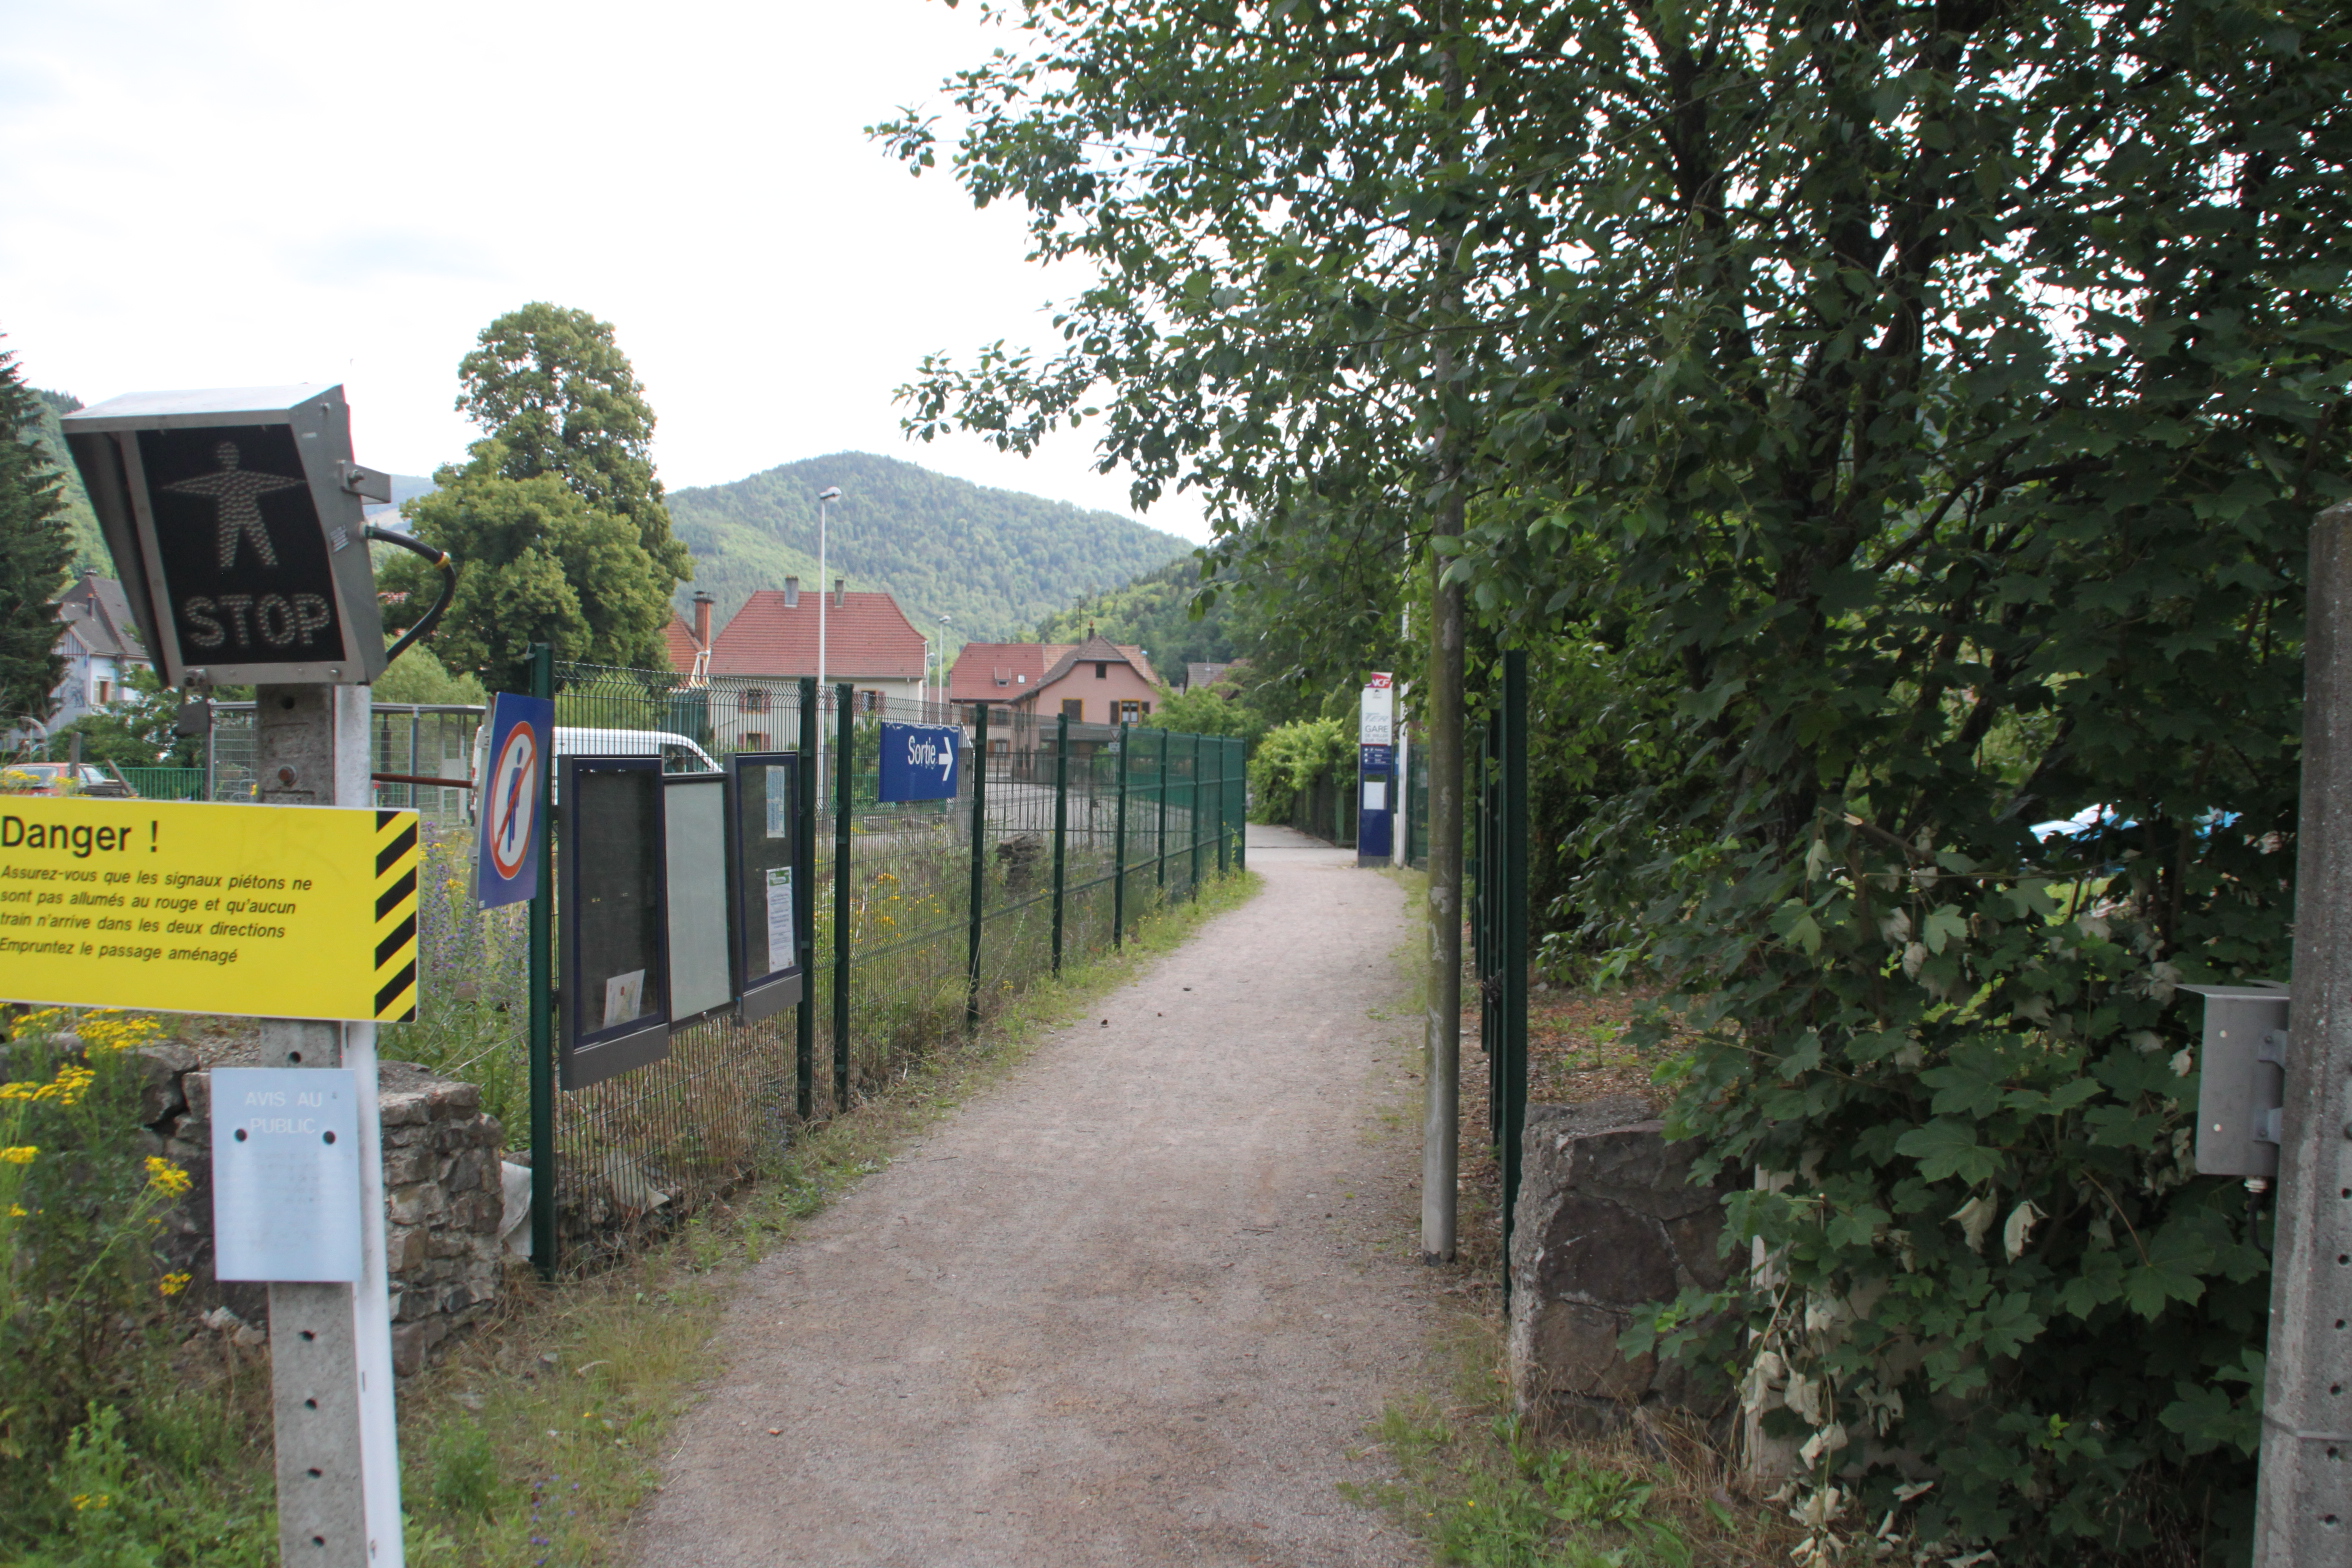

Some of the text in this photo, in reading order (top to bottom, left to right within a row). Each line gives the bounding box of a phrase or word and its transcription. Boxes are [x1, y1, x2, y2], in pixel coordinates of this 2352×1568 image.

[184, 593, 331, 647] STOP
[1364, 724, 1389, 733] GARE
[907, 735, 936, 766] Sortie
[1, 815, 158, 858] Danger !
[1, 864, 312, 891] Assurez-vous que les signaux piétons ne
[1, 890, 296, 915] sont pas allumés au rouge et qu'aucun
[1, 912, 32, 926] train
[97, 917, 132, 931] dans
[138, 918, 160, 933] les
[166, 920, 203, 934] deux
[210, 922, 286, 938] directions
[0, 937, 238, 965] Empruntez le passage aménagé
[245, 1091, 322, 1108] AVIS AU
[251, 1118, 316, 1134] PUBLIC
